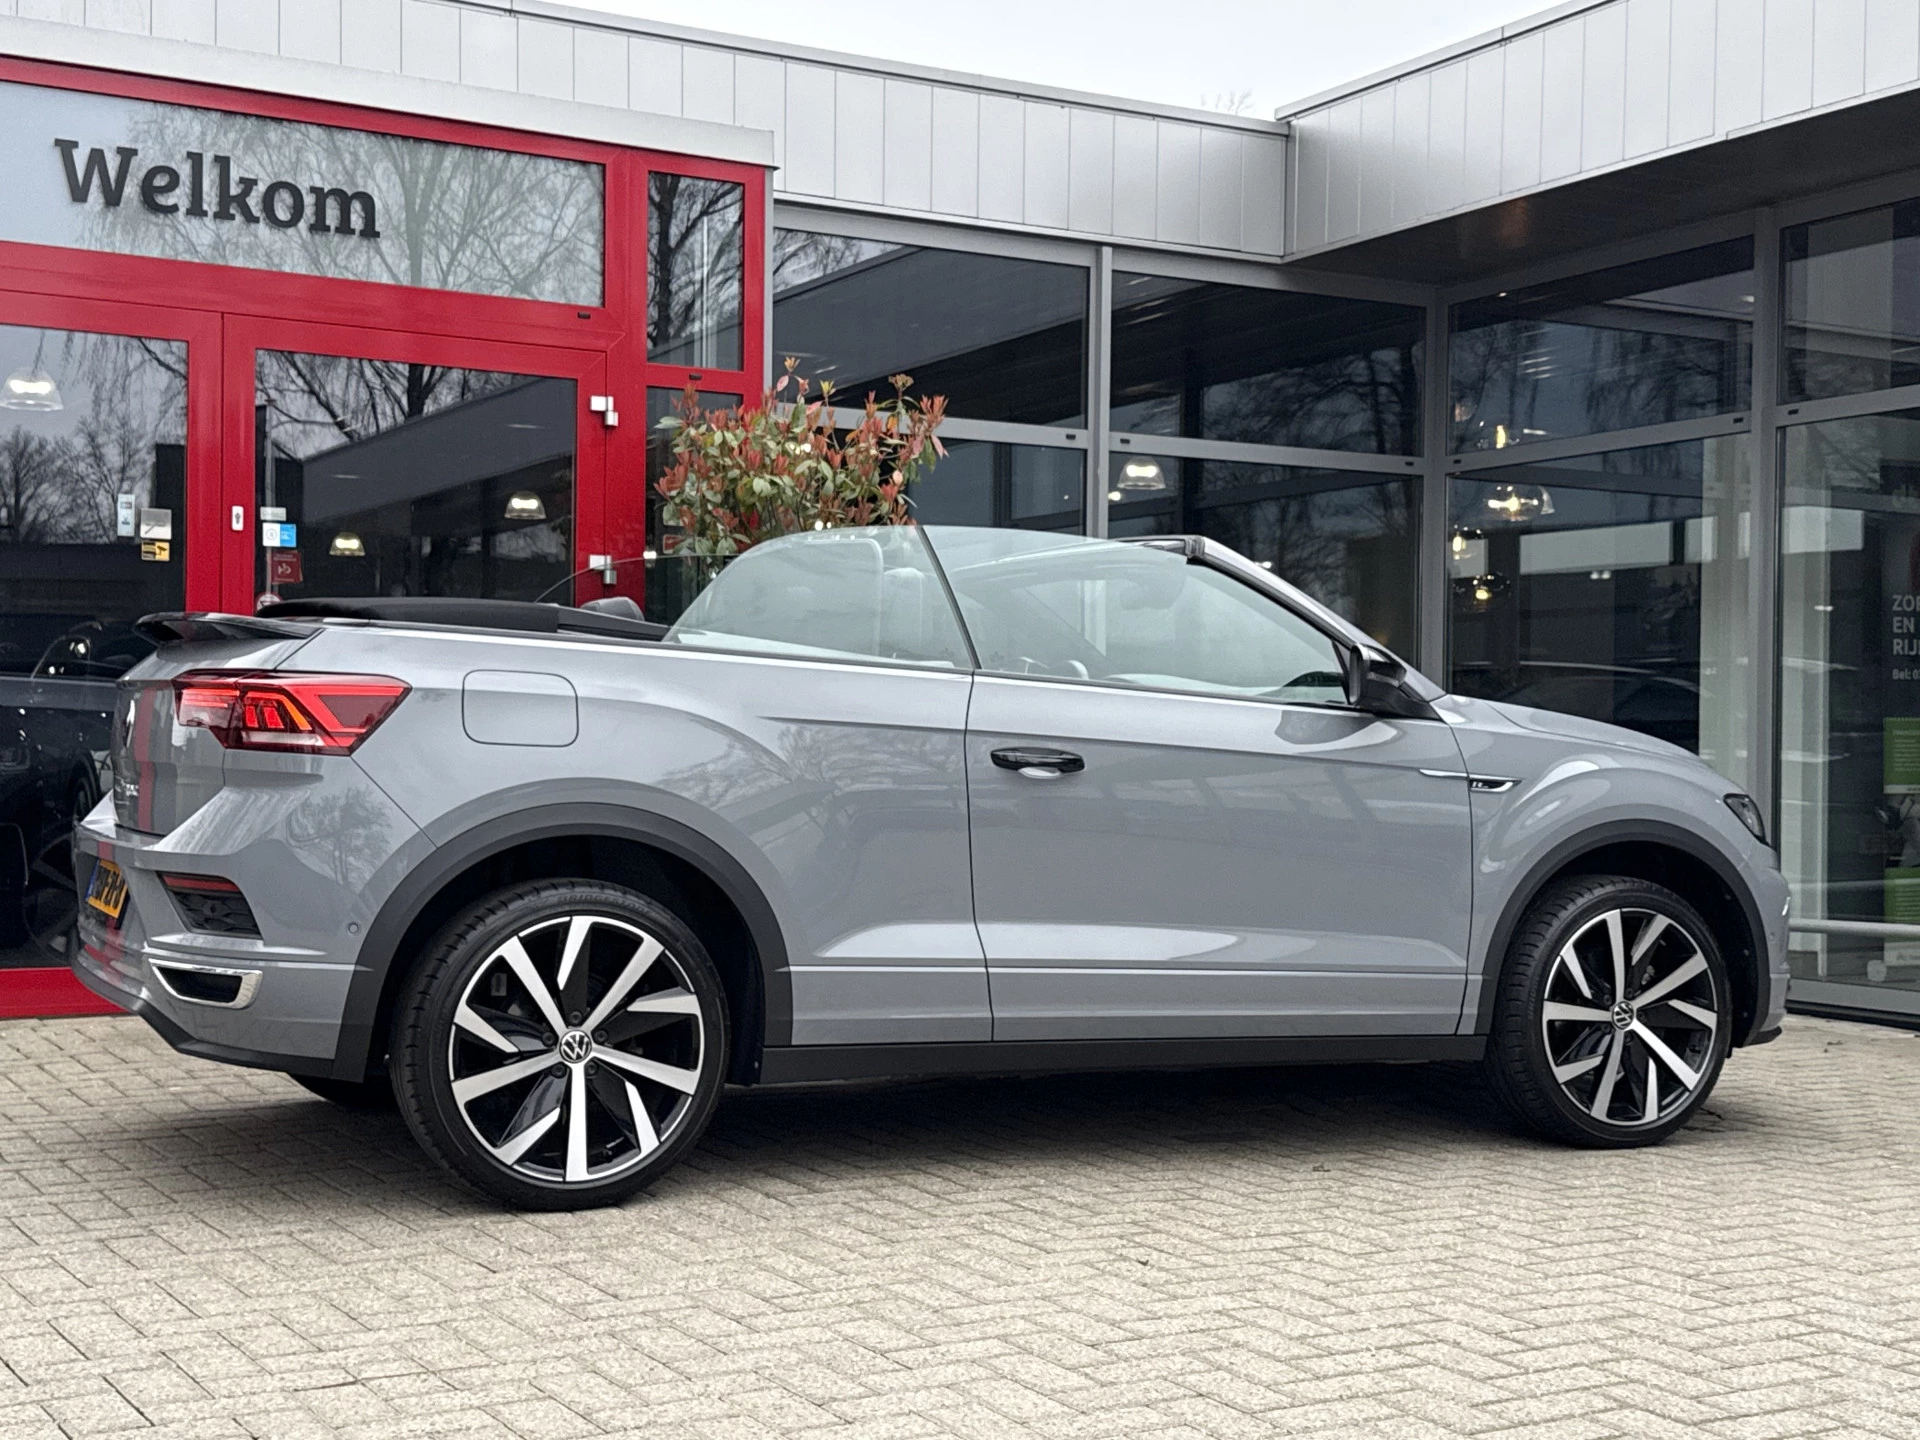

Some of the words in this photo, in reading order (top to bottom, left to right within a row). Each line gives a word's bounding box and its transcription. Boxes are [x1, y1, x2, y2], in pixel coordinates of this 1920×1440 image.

[54, 138, 381, 238] Welkom
[1892, 616, 1915, 634] EN
[1892, 639, 1920, 656] RIJ
